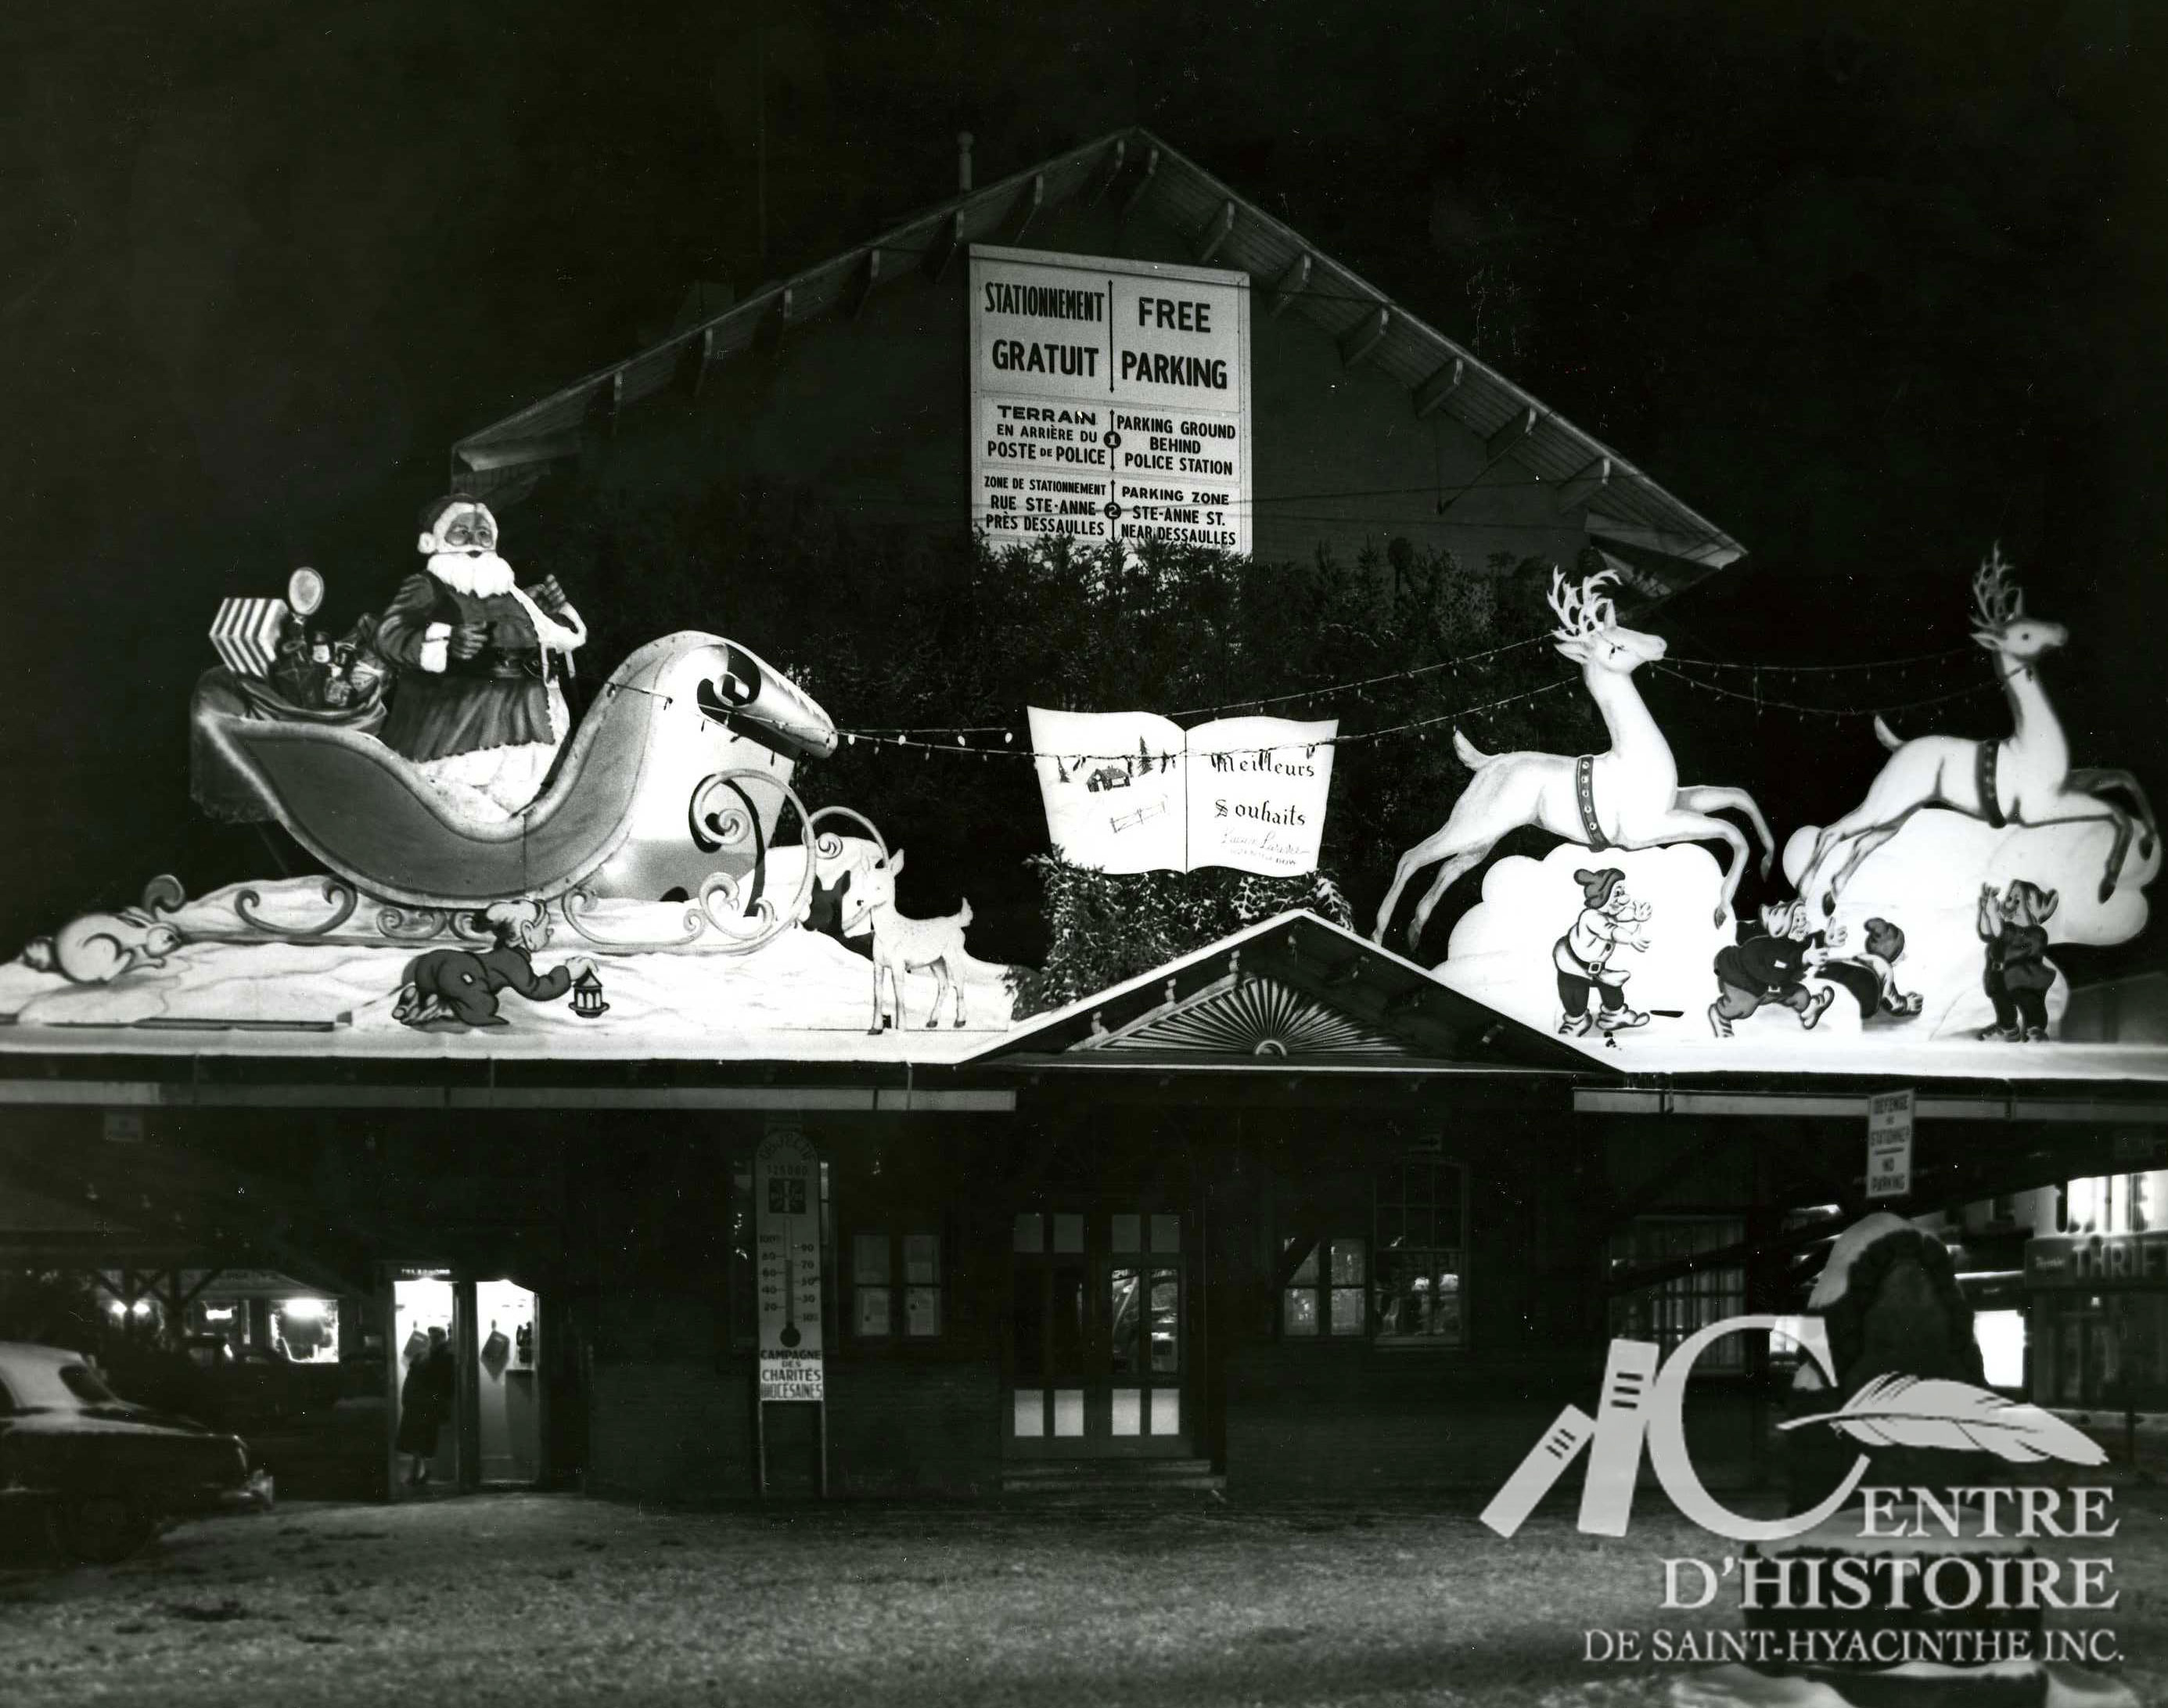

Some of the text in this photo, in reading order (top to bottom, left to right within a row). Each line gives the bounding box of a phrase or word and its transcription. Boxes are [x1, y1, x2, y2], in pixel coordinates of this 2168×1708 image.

[984, 282, 1104, 322] STATIONNEMENT
[1138, 297, 1211, 333] FREE
[992, 339, 1098, 377] GRATUIT
[1121, 350, 1228, 389] PARKING
[997, 405, 1096, 426] TERRAIN
[1116, 415, 1236, 440] PARKING GROUND
[997, 423, 1098, 443] EN ARRIÈRE DU
[1149, 436, 1201, 454] BEHIND
[987, 440, 1106, 465] POSTE DE POLICE
[1124, 452, 1232, 476] POLICE STATION
[984, 476, 1106, 495] ZONE DE STATIONNEMENT
[1122, 486, 1229, 505] PARKING ZONE
[991, 494, 1096, 516] RUE STE-ANNE
[1132, 505, 1225, 526] STE-ANNE ST.
[986, 511, 1105, 536] PRÈS DESSAULLES
[1121, 523, 1236, 545] NEAR DESSAULLES
[1215, 752, 1314, 776] Meilleurs
[1216, 799, 1306, 825] Souhaits
[760, 1349, 822, 1360] CAMPAGNE
